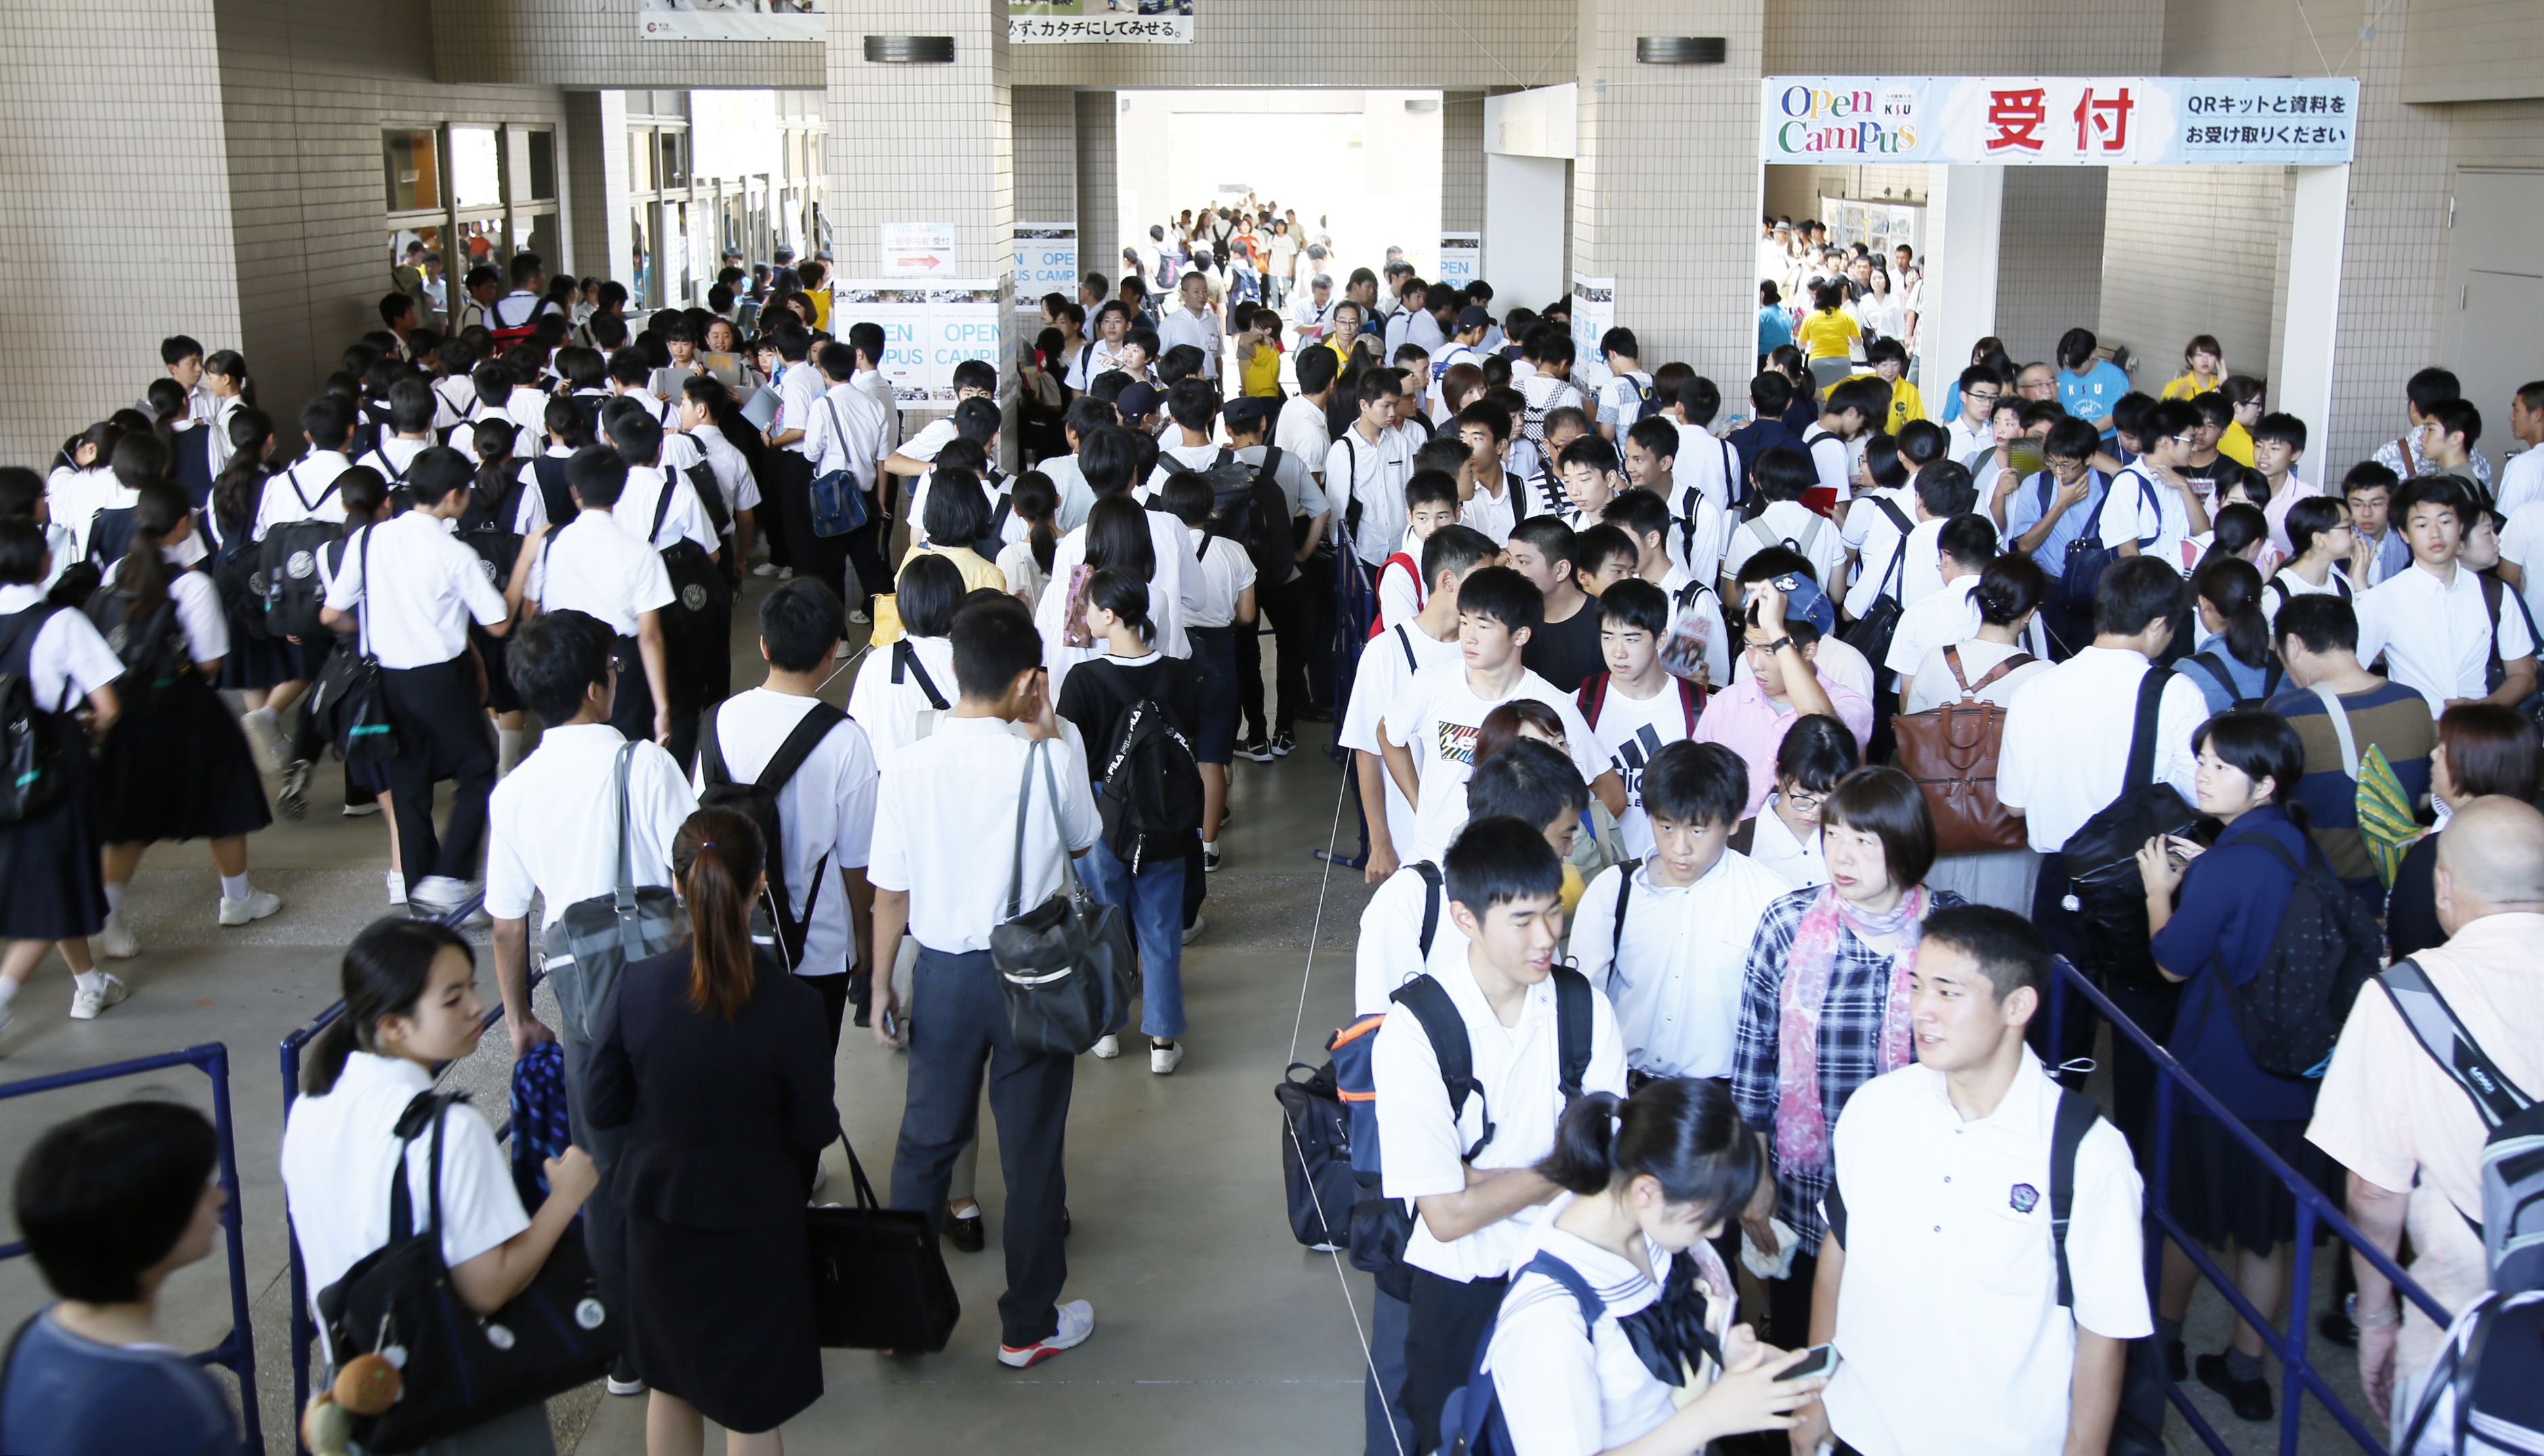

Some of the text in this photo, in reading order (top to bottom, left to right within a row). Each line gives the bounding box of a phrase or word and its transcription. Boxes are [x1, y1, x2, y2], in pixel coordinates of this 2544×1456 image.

[1781, 85, 1874, 119] Open
[1884, 104, 1912, 115] KSU
[2187, 96, 2346, 115] QRキットと資料を
[1985, 87, 2135, 150] 受付
[1778, 121, 1916, 154] Campus
[2186, 126, 2346, 144] お受け取りください
[933, 237, 950, 245] 受付
[1043, 252, 1075, 266] OPE
[1441, 262, 1470, 274] PEN
[1036, 270, 1075, 281] CAMP
[2068, 383, 2102, 397] KSU
[1120, 733, 1133, 755] FILA
[1107, 754, 1125, 775] FILA
